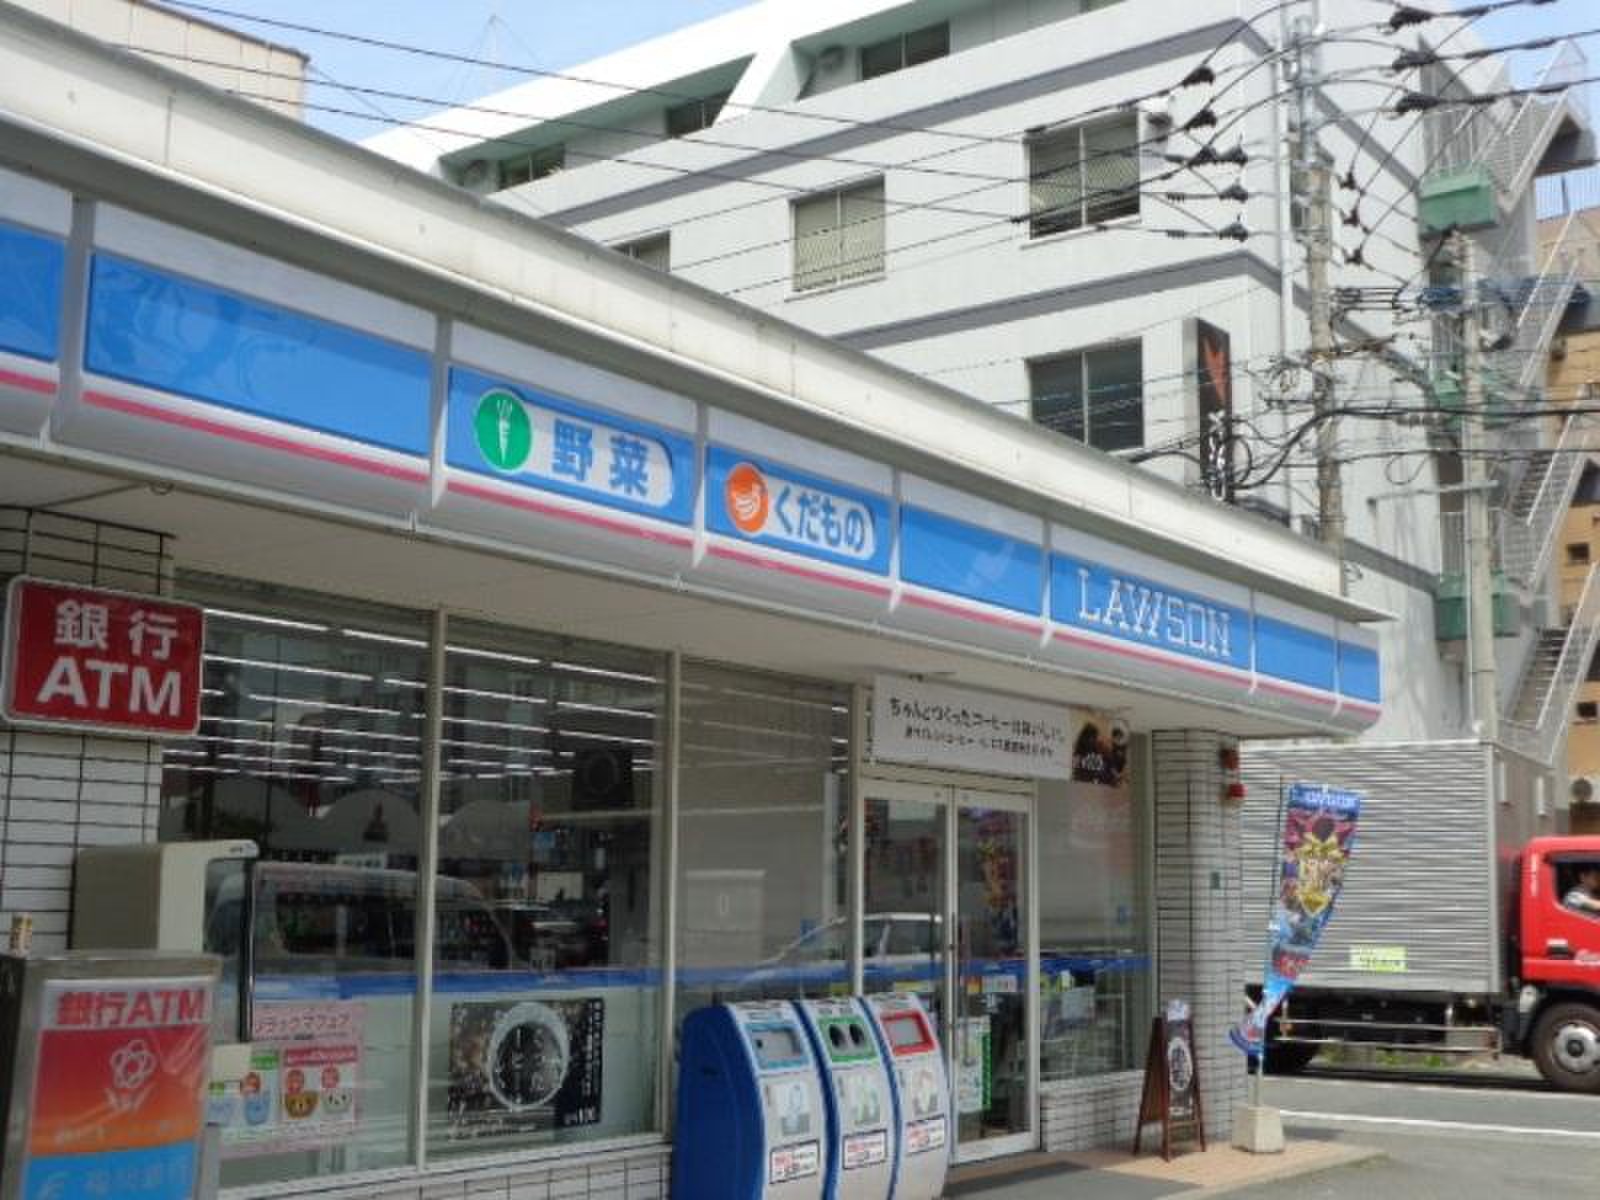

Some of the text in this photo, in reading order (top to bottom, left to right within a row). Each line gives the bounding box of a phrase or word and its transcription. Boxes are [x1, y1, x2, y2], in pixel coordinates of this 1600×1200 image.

[551, 418, 649, 496] 野菜
[775, 484, 866, 554] くだもの
[54, 598, 179, 661] 銀行
[1077, 568, 1233, 658] LAWSON
[36, 655, 183, 718] ATM
